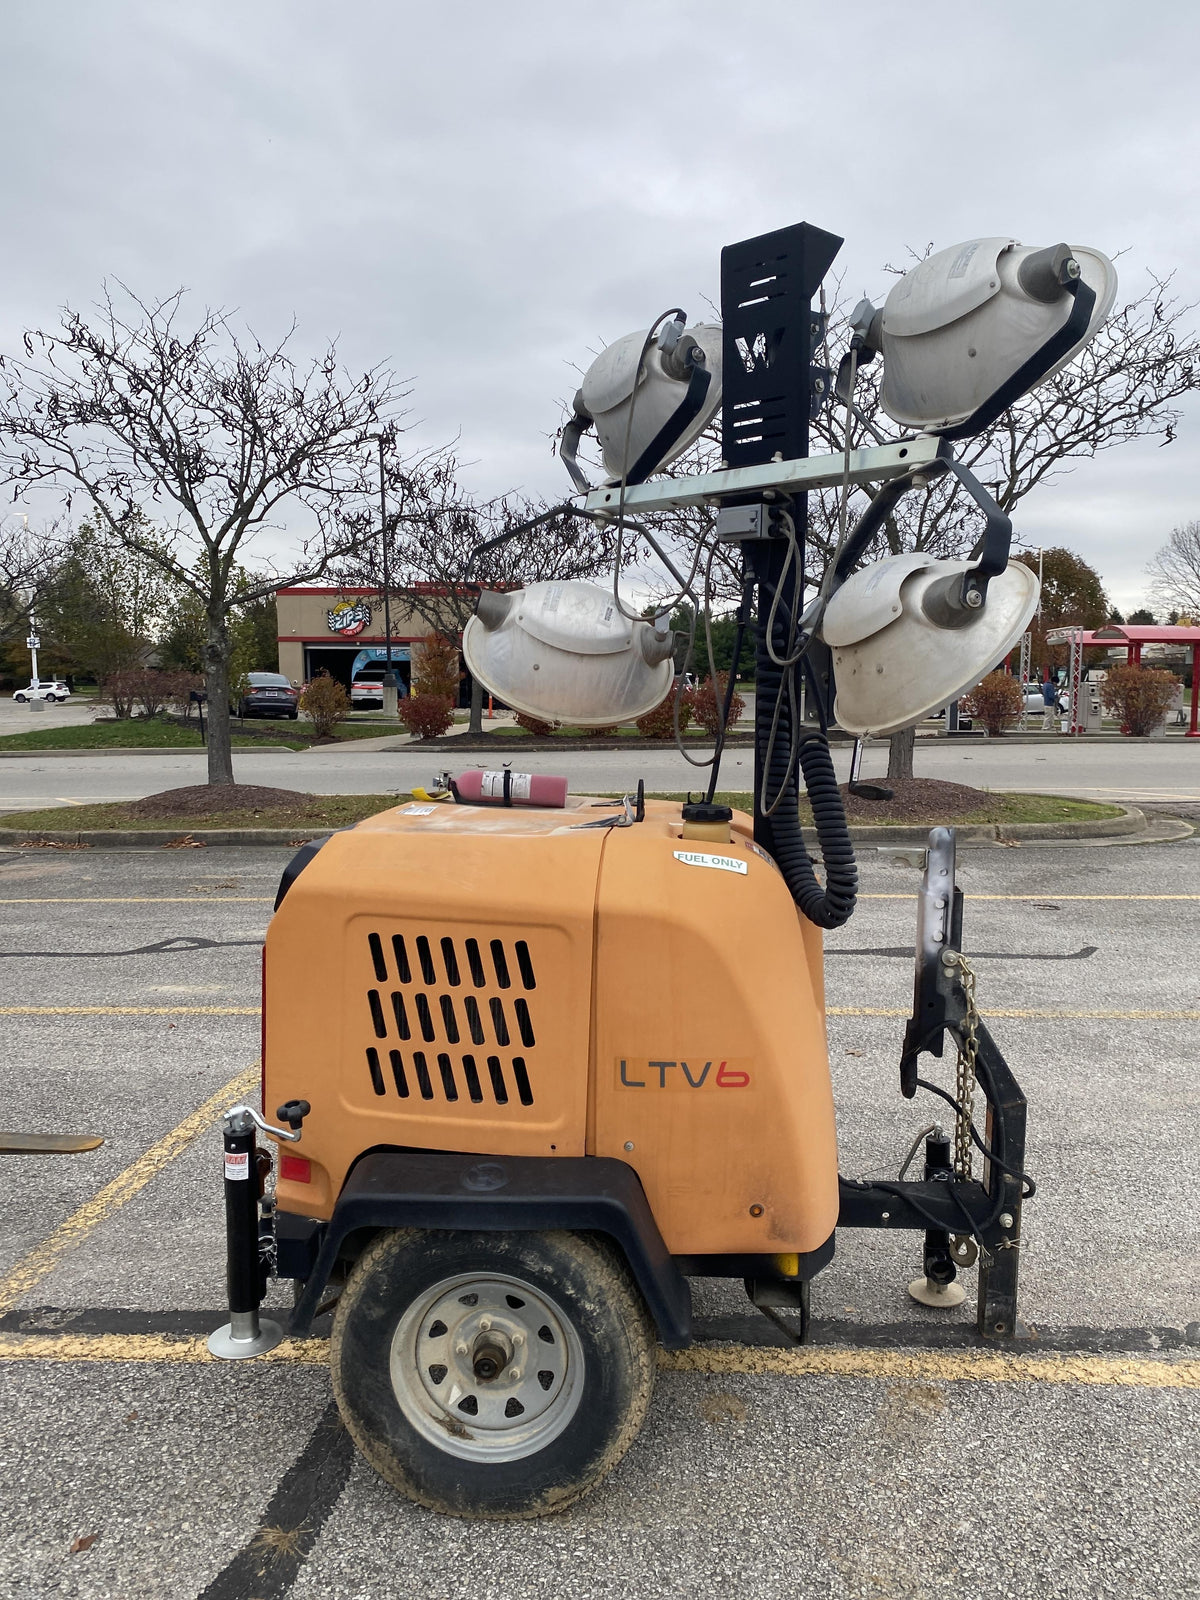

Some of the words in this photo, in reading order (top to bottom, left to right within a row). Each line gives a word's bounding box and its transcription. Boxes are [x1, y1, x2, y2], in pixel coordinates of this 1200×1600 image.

[334, 607, 363, 630] ZIPS
[677, 853, 709, 864] FUEL
[711, 857, 743, 869] ONLY
[620, 1060, 750, 1088] LTV6
